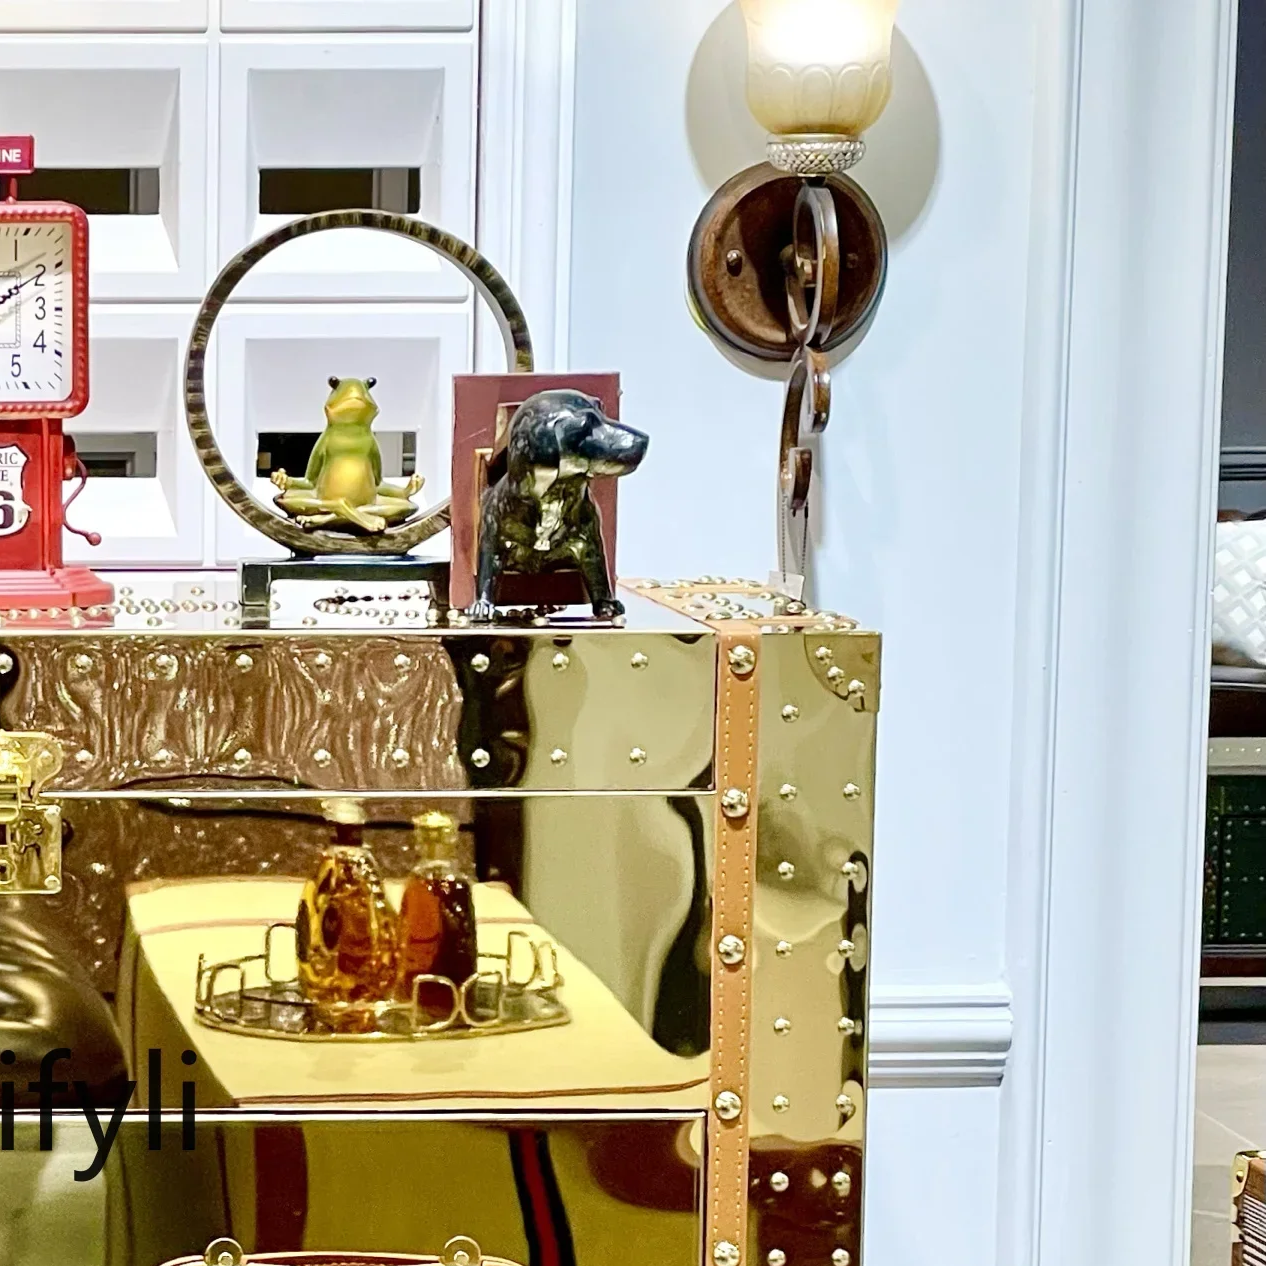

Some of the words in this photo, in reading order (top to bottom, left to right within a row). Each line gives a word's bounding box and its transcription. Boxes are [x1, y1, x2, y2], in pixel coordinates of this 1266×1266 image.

[13, 239, 18, 262] 1
[33, 264, 47, 287] 2
[34, 297, 46, 320] 3
[32, 330, 47, 354] 4
[10, 354, 21, 378] 5
